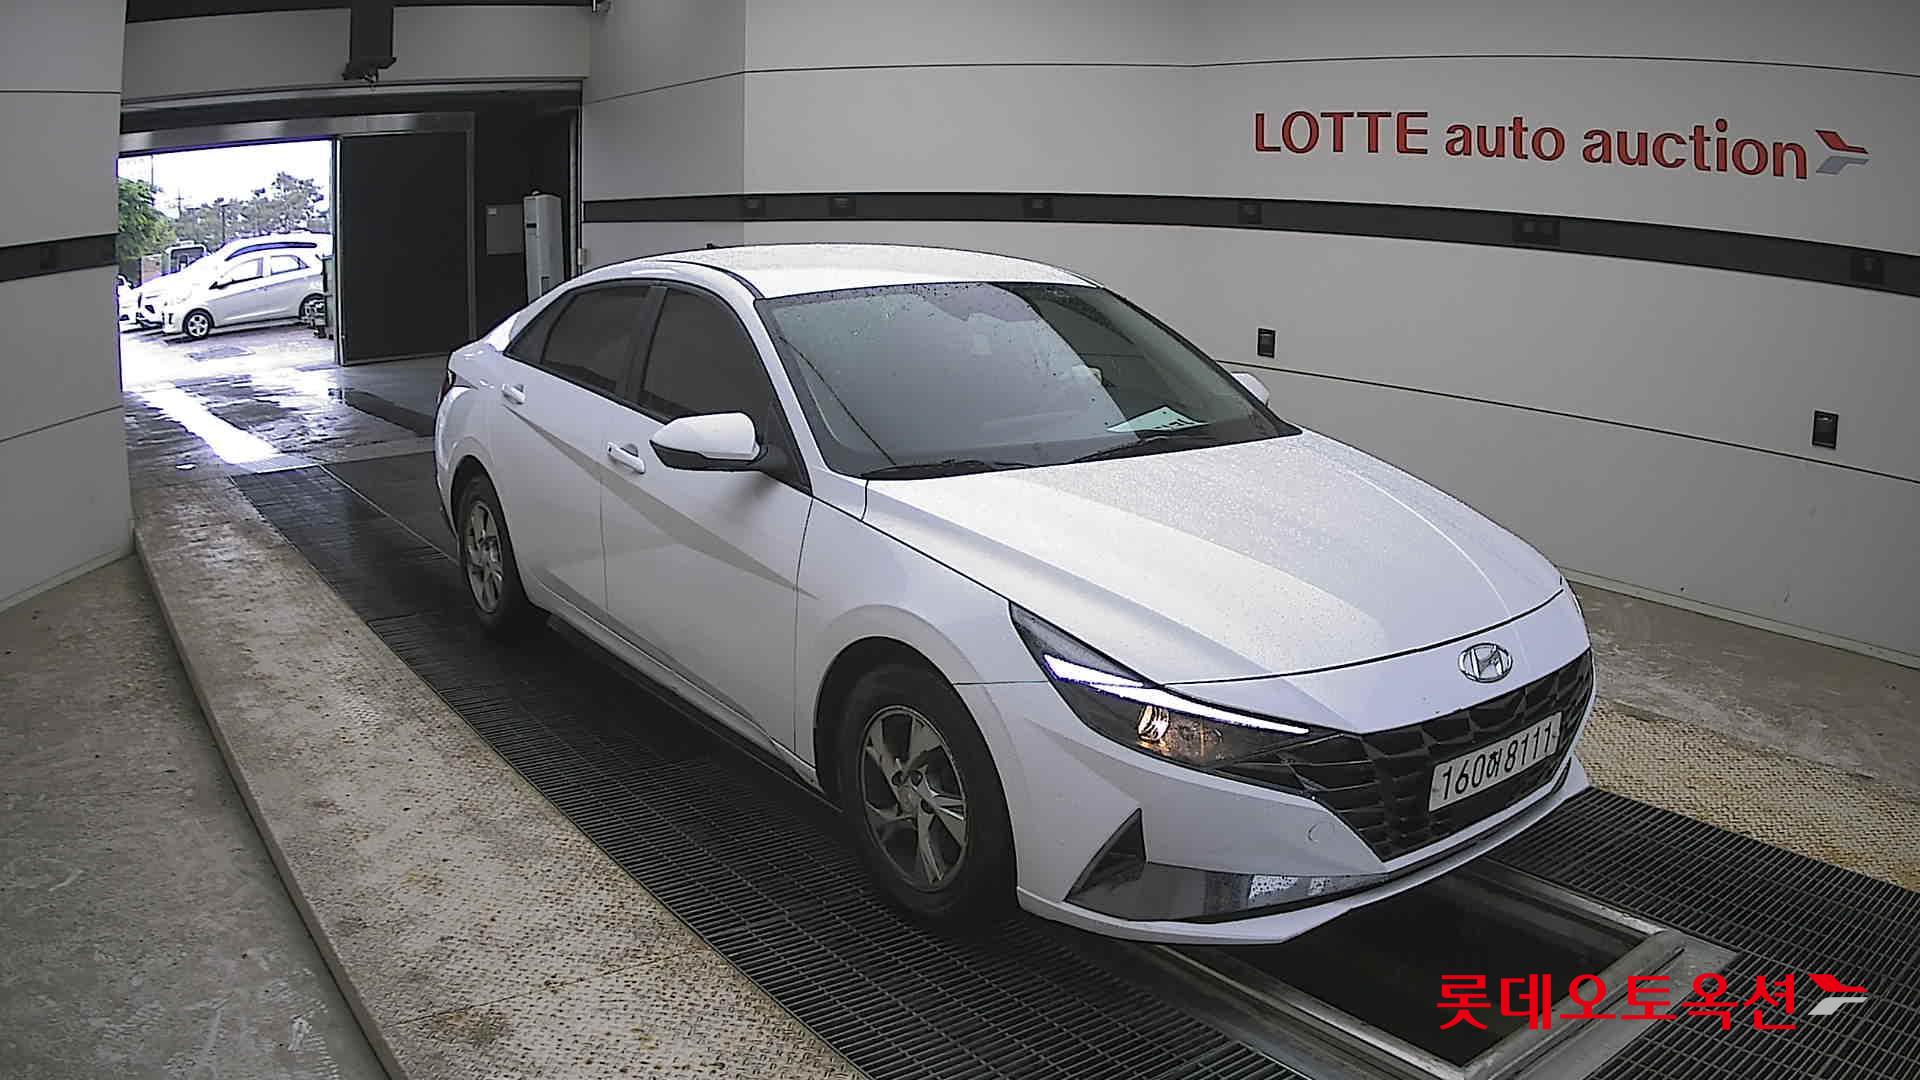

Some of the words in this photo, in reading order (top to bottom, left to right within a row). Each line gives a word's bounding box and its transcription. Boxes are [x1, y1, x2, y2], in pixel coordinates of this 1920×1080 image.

[1254, 111, 1428, 155] LOTTE
[1445, 116, 1566, 160] auto
[1582, 119, 1809, 179] auction
